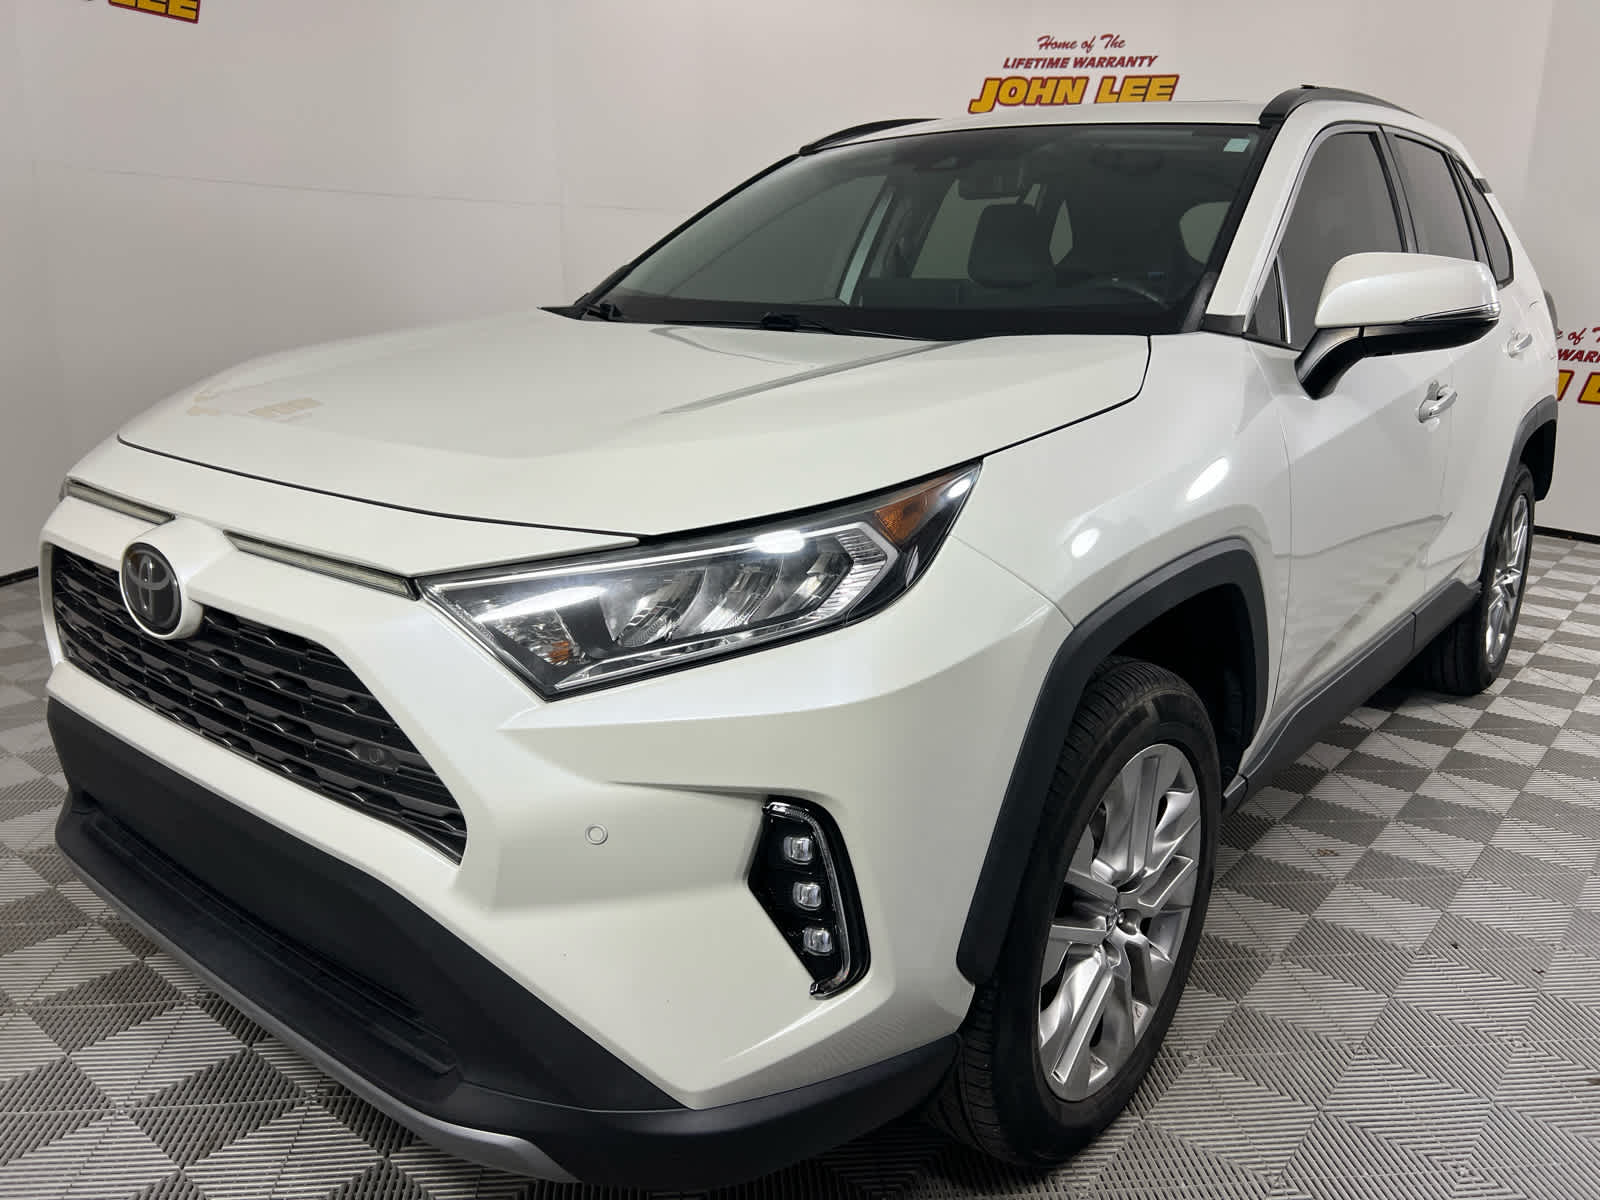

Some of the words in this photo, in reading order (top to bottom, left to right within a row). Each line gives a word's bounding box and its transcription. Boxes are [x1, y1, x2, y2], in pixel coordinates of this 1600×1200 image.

[1037, 35, 1078, 50] Home
[1080, 36, 1096, 52] of
[1100, 34, 1126, 49] The
[1003, 57, 1070, 69] LIFETIME
[1073, 55, 1158, 68] WARRANTY
[968, 76, 1089, 114] JOHN
[1094, 74, 1179, 104] LEE
[1568, 328, 1587, 345] of
[1557, 349, 1600, 362] WAR
